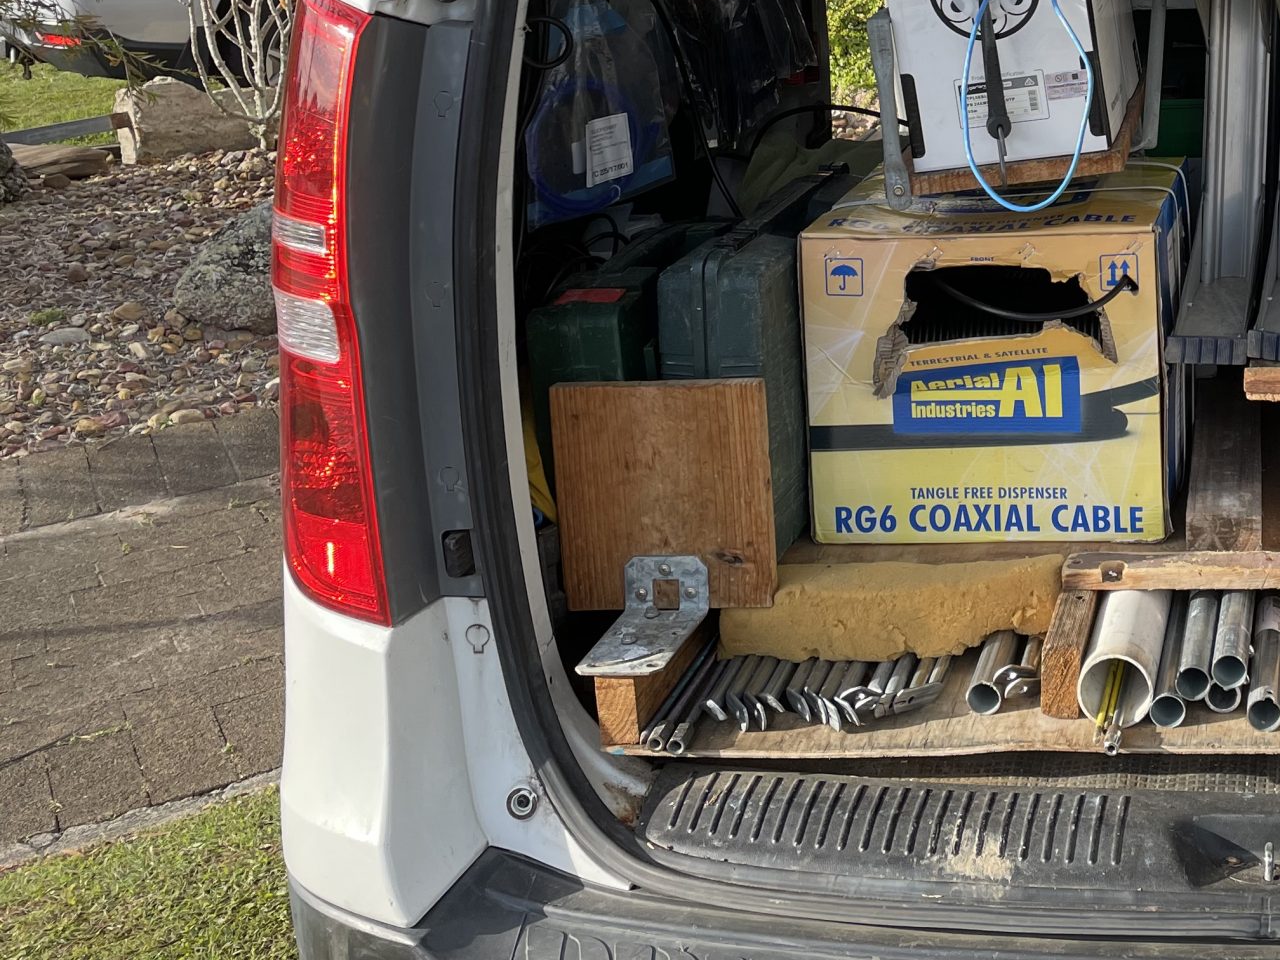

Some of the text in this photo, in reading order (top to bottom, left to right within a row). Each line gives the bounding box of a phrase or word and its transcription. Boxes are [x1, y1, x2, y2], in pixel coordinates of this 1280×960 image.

[1046, 213, 1137, 227] CABLE
[910, 353, 980, 367] TERRESTRIAL
[995, 347, 1049, 358] SATELLITE
[911, 373, 1000, 391] Aerial
[999, 364, 1063, 418] AI
[911, 402, 996, 419] Industries
[911, 487, 1068, 500] TANGLE FREE DISPENSER
[835, 503, 1145, 534] RG6 COAXIAL CABLE
